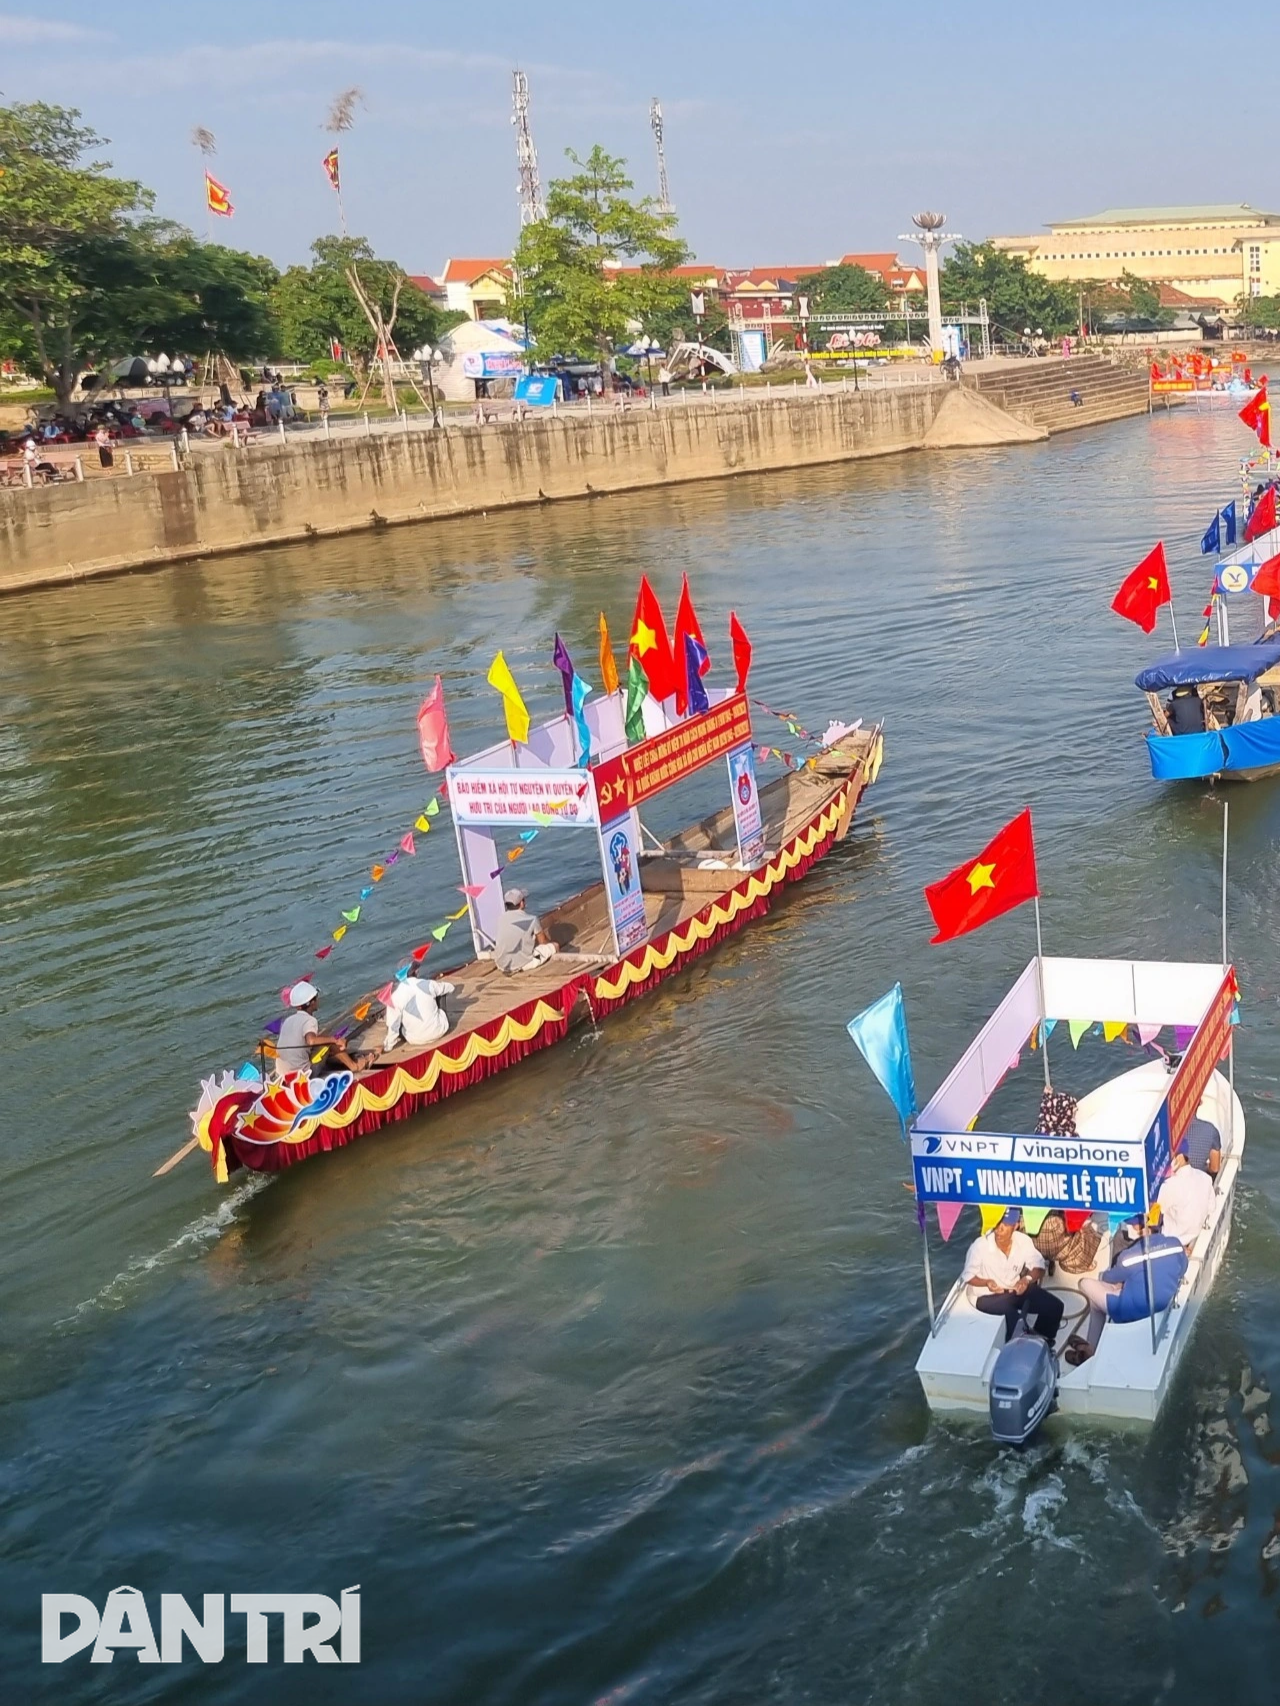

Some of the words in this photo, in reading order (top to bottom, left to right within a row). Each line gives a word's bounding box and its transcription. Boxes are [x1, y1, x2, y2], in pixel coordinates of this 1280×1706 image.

[946, 1140, 999, 1154] VNPT
[1023, 1142, 1130, 1163] vinaphone
[921, 1166, 962, 1193] VNPT
[976, 1168, 1068, 1200] VINAPHONE
[1072, 1169, 1092, 1207] LỆ
[1094, 1167, 1136, 1204] THỦY
